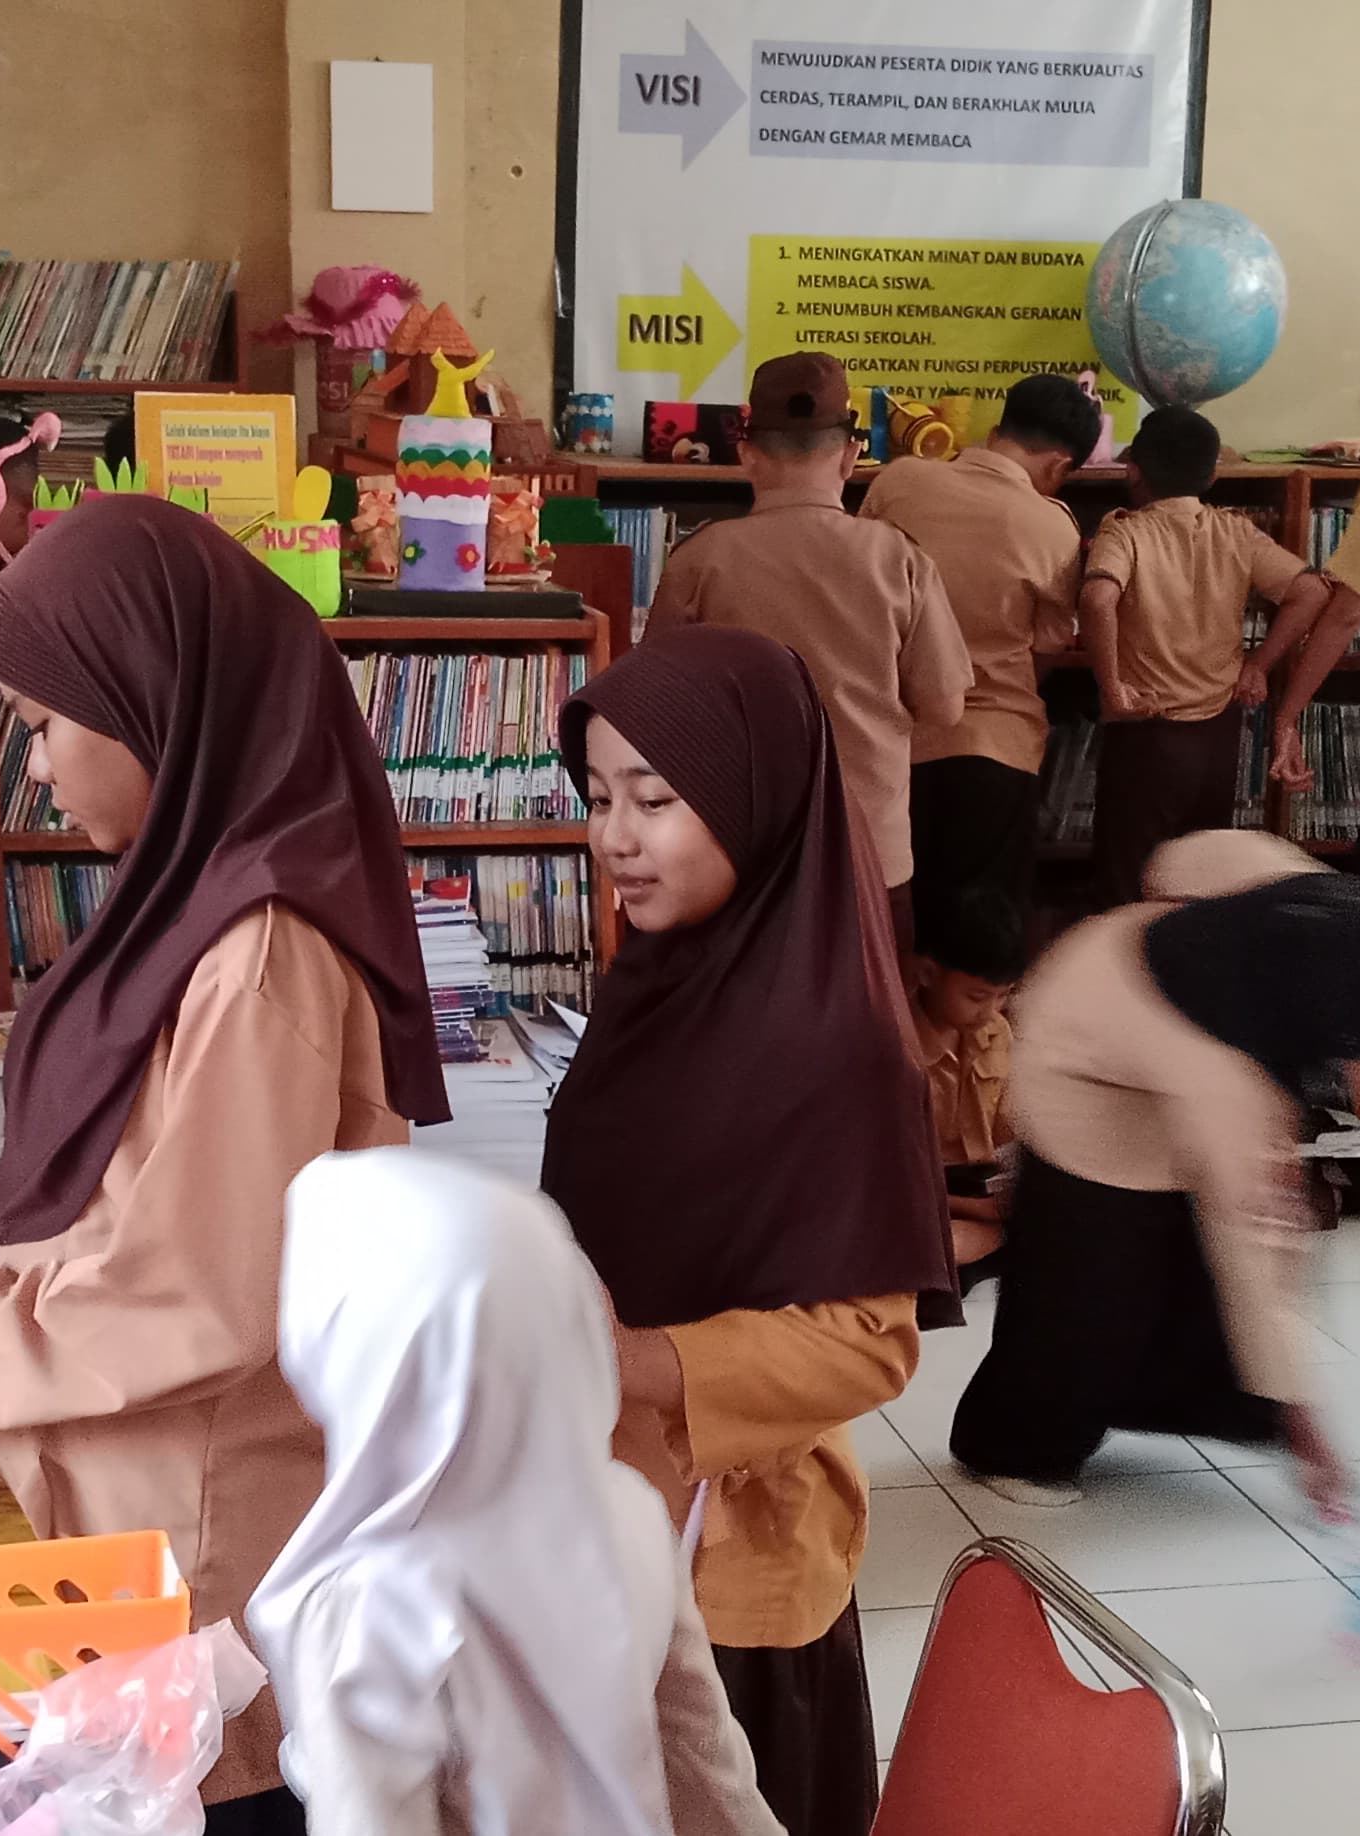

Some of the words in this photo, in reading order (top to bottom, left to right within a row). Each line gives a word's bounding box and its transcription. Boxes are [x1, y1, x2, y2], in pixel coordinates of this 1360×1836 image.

[761, 51, 876, 69] MEWUJUDKAN
[881, 56, 946, 73] PESERTA
[951, 58, 992, 74] DIDIK
[996, 61, 1039, 76] YANG
[1043, 62, 1143, 79] BERKUALITAS
[635, 73, 702, 107] VISI
[760, 89, 824, 107] CERDAS,
[828, 92, 909, 110] TERAMPIL,
[914, 96, 947, 110] DAN
[952, 97, 1040, 113] BERAKHLAK
[1045, 100, 1096, 114] MULIA
[759, 127, 825, 144] DENGAN
[829, 130, 887, 146] GEMAR
[891, 132, 972, 148] MEMBACA
[779, 246, 791, 259] 1.
[799, 247, 924, 262] MENINGKATKAN
[928, 250, 980, 264] MINAT
[984, 251, 1017, 265] DAN
[1021, 252, 1084, 266] BUDAYA
[798, 275, 879, 289] MEMBACA
[882, 276, 935, 290] SISWA.
[776, 302, 789, 315] 2.
[796, 302, 893, 317] MENUMBUH
[896, 304, 1006, 319] KEMBANGKAN
[1010, 306, 1082, 321] GERAKAN
[628, 312, 704, 346] MISI
[796, 330, 859, 343] LITERASI
[864, 331, 936, 345] SEKOLAH.
[840, 358, 920, 372] NGKATKAN
[924, 359, 979, 373] FUNGSI
[984, 360, 1101, 375] PERPUSTAKAAN
